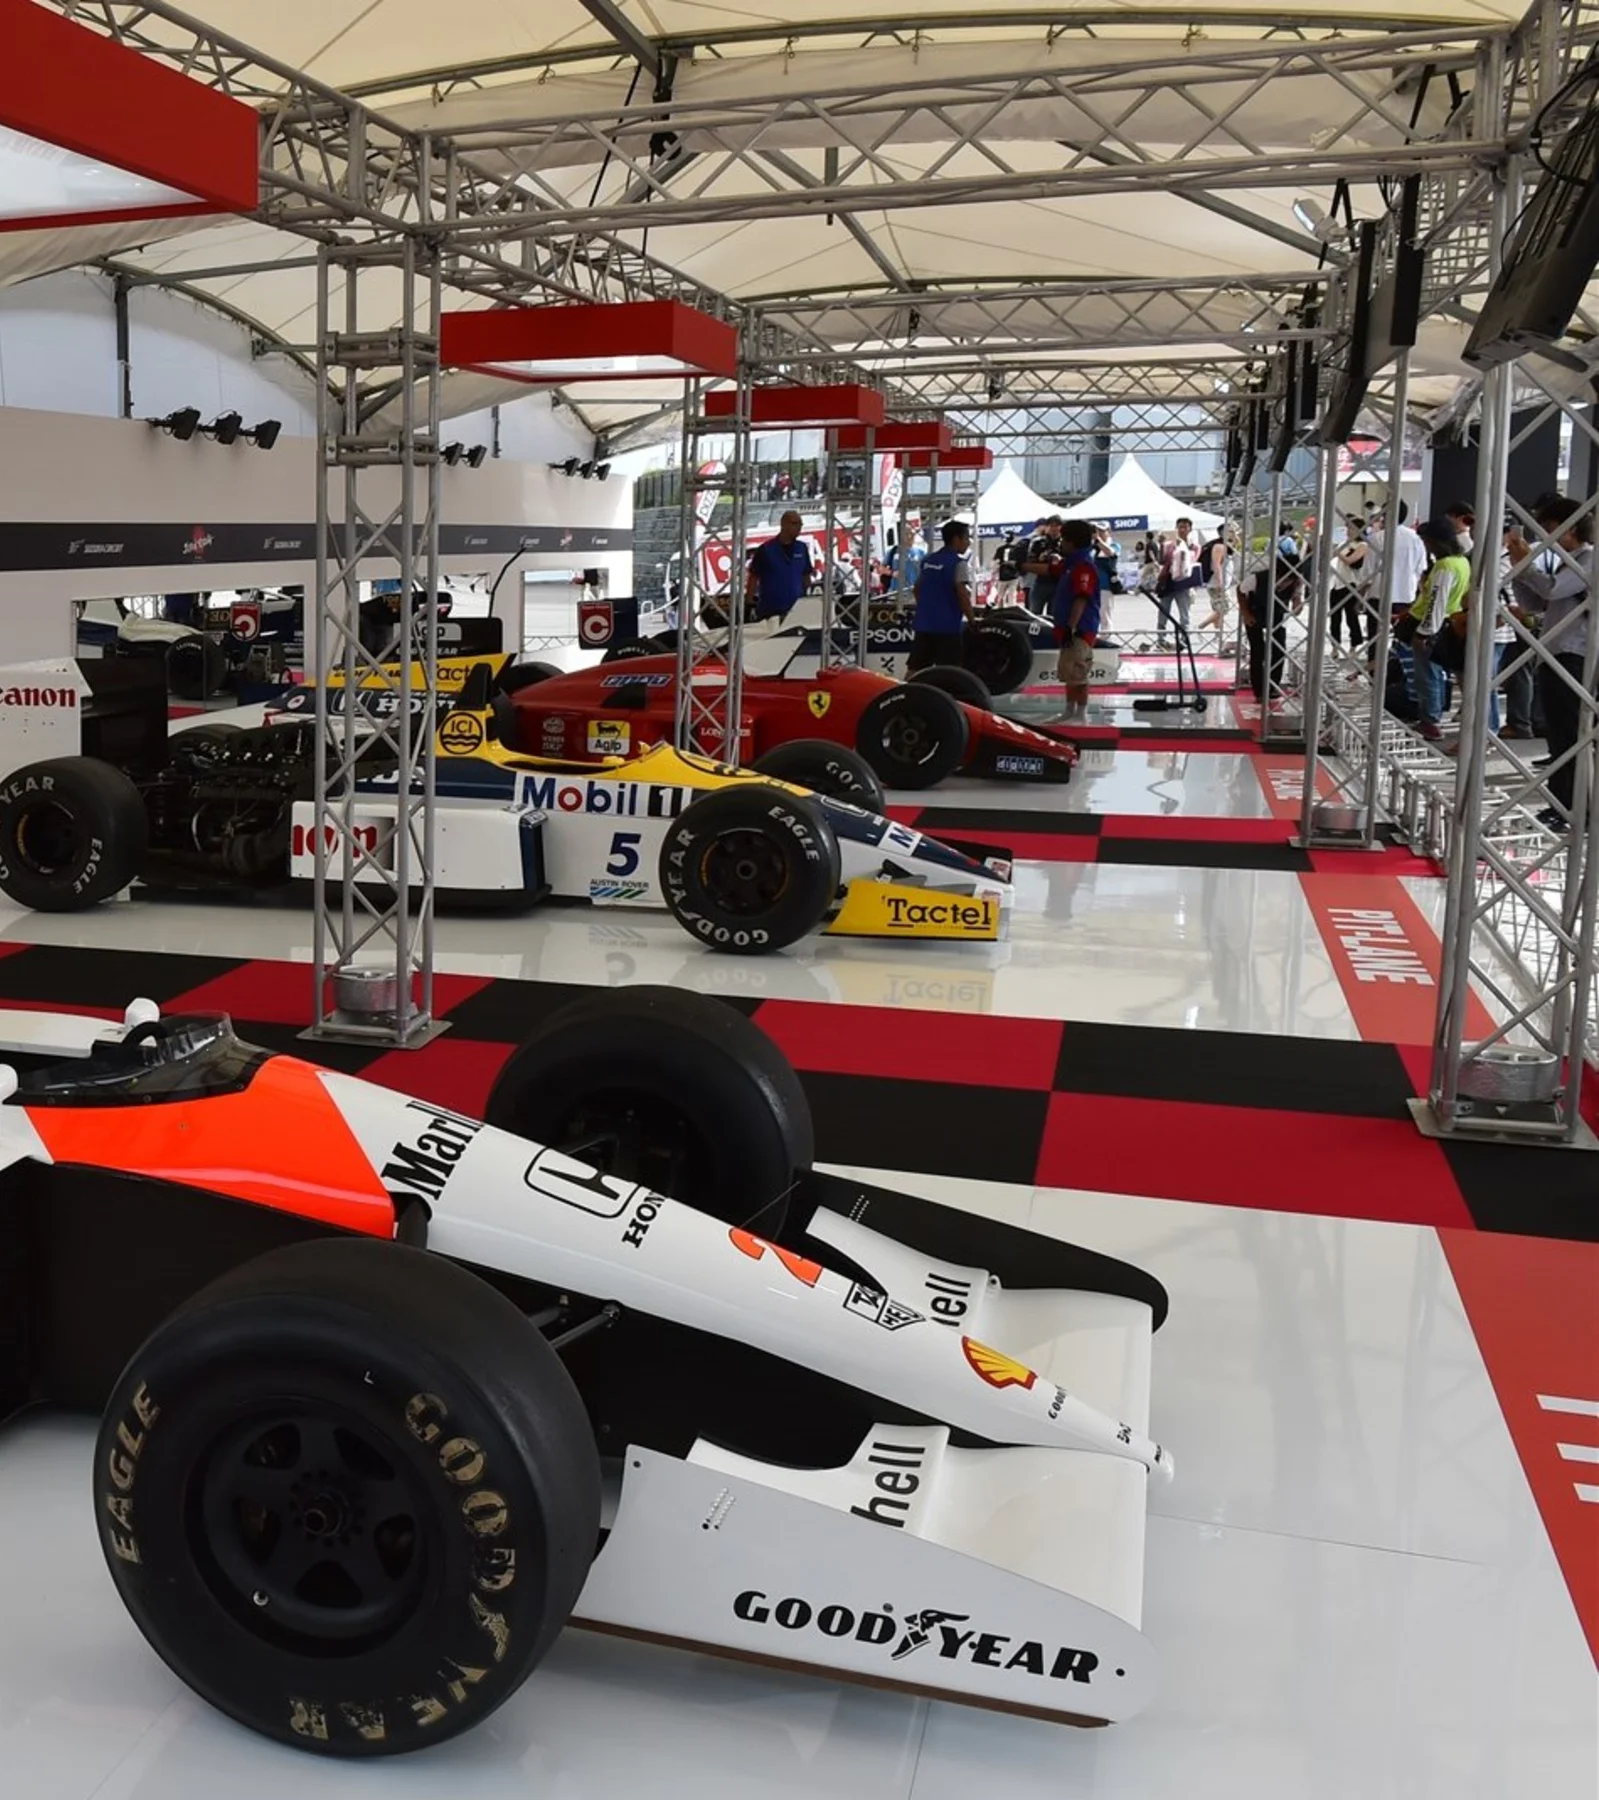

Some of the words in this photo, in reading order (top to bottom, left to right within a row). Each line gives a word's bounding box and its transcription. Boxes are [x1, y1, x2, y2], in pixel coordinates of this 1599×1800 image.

[1114, 519, 1140, 529] SHOP
[849, 628, 915, 644] EPSON
[603, 675, 669, 687] FIAT
[450, 720, 473, 733] ICI
[595, 738, 622, 752] Agip
[523, 775, 638, 816] Mobil
[606, 832, 642, 877] 5
[768, 805, 821, 861] EAGLE
[73, 837, 103, 894] EAGLE
[589, 878, 620, 887] AUSTIN
[621, 880, 649, 888] ROVER
[887, 898, 992, 926] Tactel
[1327, 908, 1436, 986] PIT-LANE
[381, 1100, 485, 1201] Marl
[621, 1187, 672, 1249] HON
[925, 1272, 973, 1327] ell
[106, 1380, 161, 1564] EAGLE
[850, 1442, 925, 1528] hell
